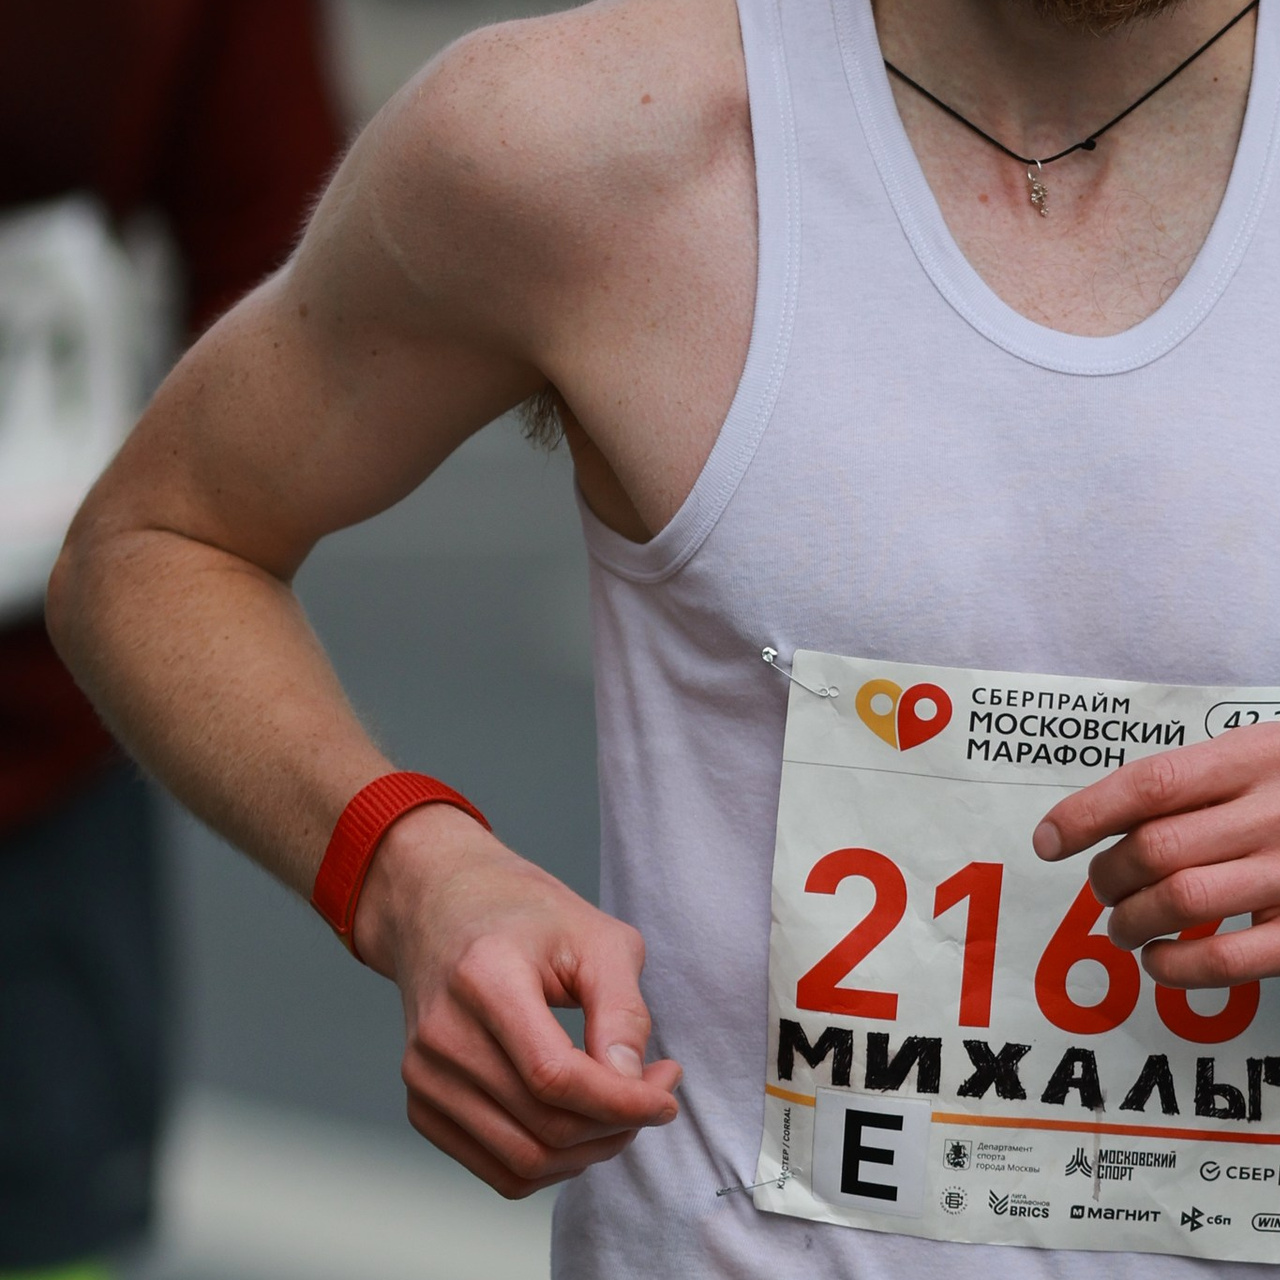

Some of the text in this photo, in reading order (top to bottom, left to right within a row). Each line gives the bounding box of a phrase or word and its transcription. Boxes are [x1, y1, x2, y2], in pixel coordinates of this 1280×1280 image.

[971, 687, 1131, 715] СБЕРПРАЙМ
[968, 711, 1186, 746] МОСКОВСКИЙ
[966, 738, 1126, 768] МАРАФОН
[782, 1107, 791, 1142] CORRAL
[977, 1142, 1034, 1153] Департамент
[977, 1153, 1006, 1162] спорта
[1098, 1149, 1177, 1169] МОСКОВСКИЙ
[976, 1162, 1040, 1173] города Москвы
[1096, 1165, 1135, 1181] СПОРТ
[1226, 1166, 1276, 1181] СБЕР
[1010, 1199, 1050, 1207] МАРАФОНОВ
[1009, 1206, 1050, 1219] BRICS
[1206, 1213, 1232, 1226] сбп
